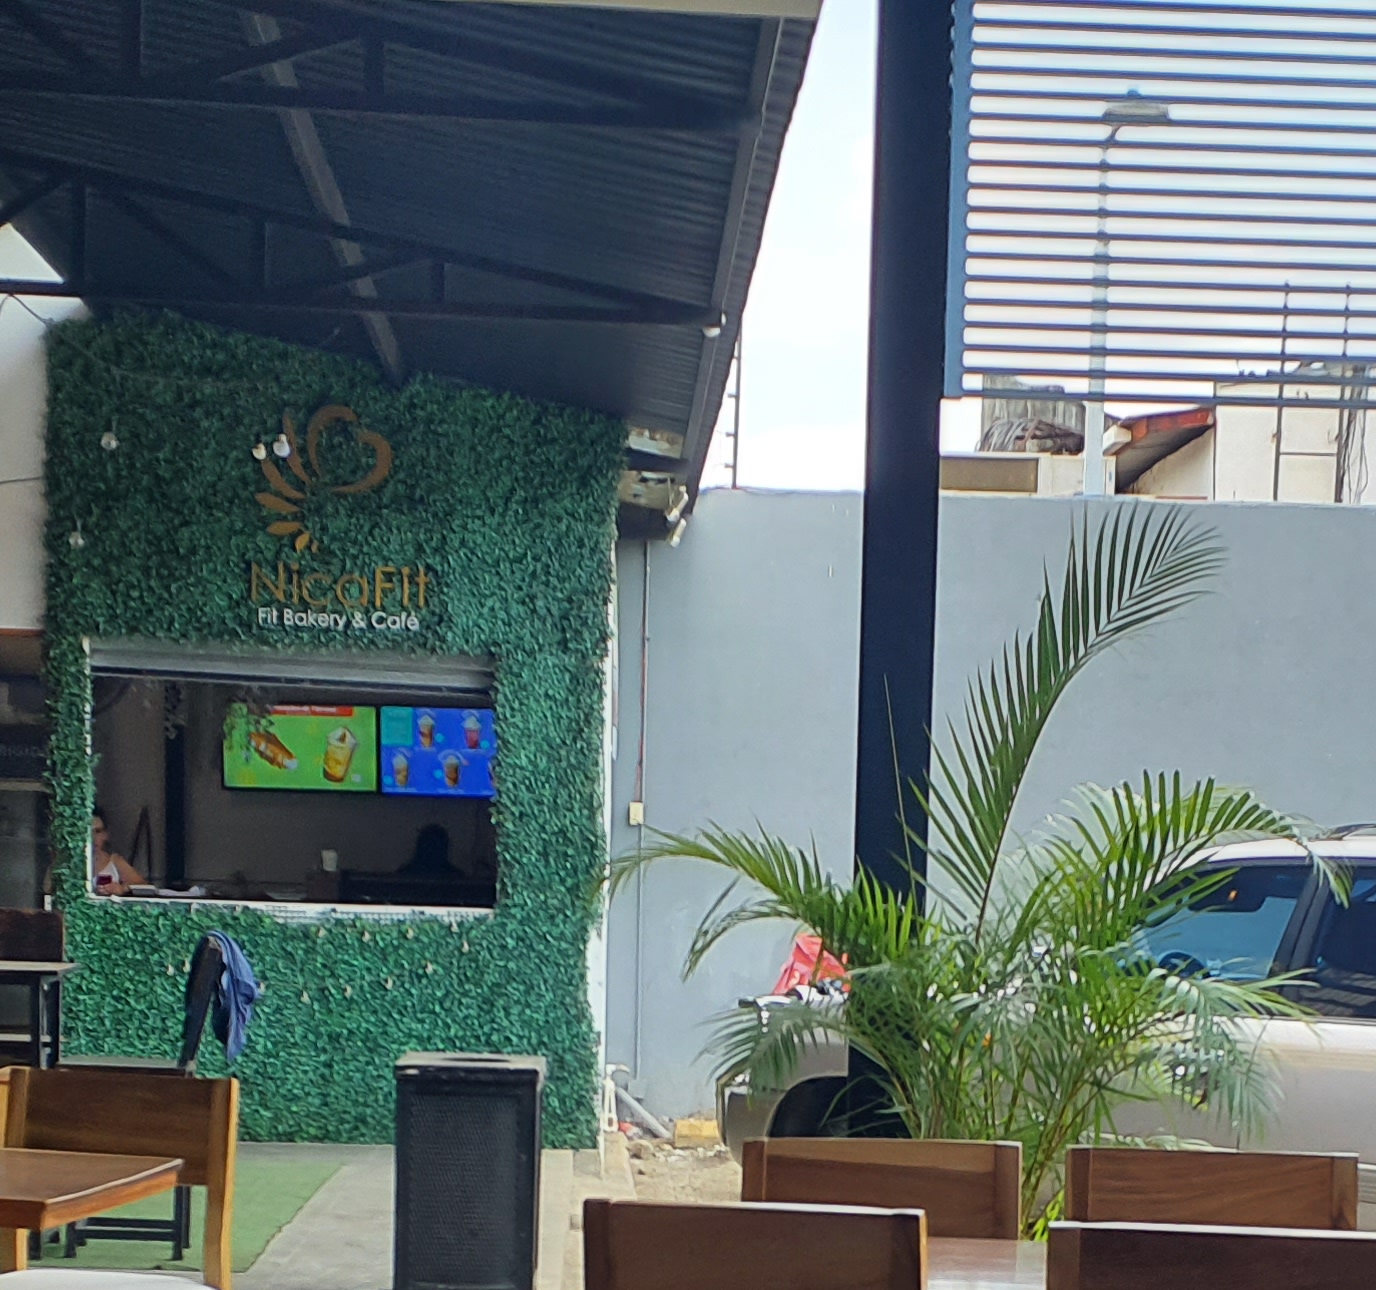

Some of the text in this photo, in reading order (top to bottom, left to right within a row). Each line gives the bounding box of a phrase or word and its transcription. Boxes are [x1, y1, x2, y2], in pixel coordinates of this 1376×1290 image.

[250, 561, 430, 608] NicaFit
[258, 608, 420, 632] Fit Bakery & Café
